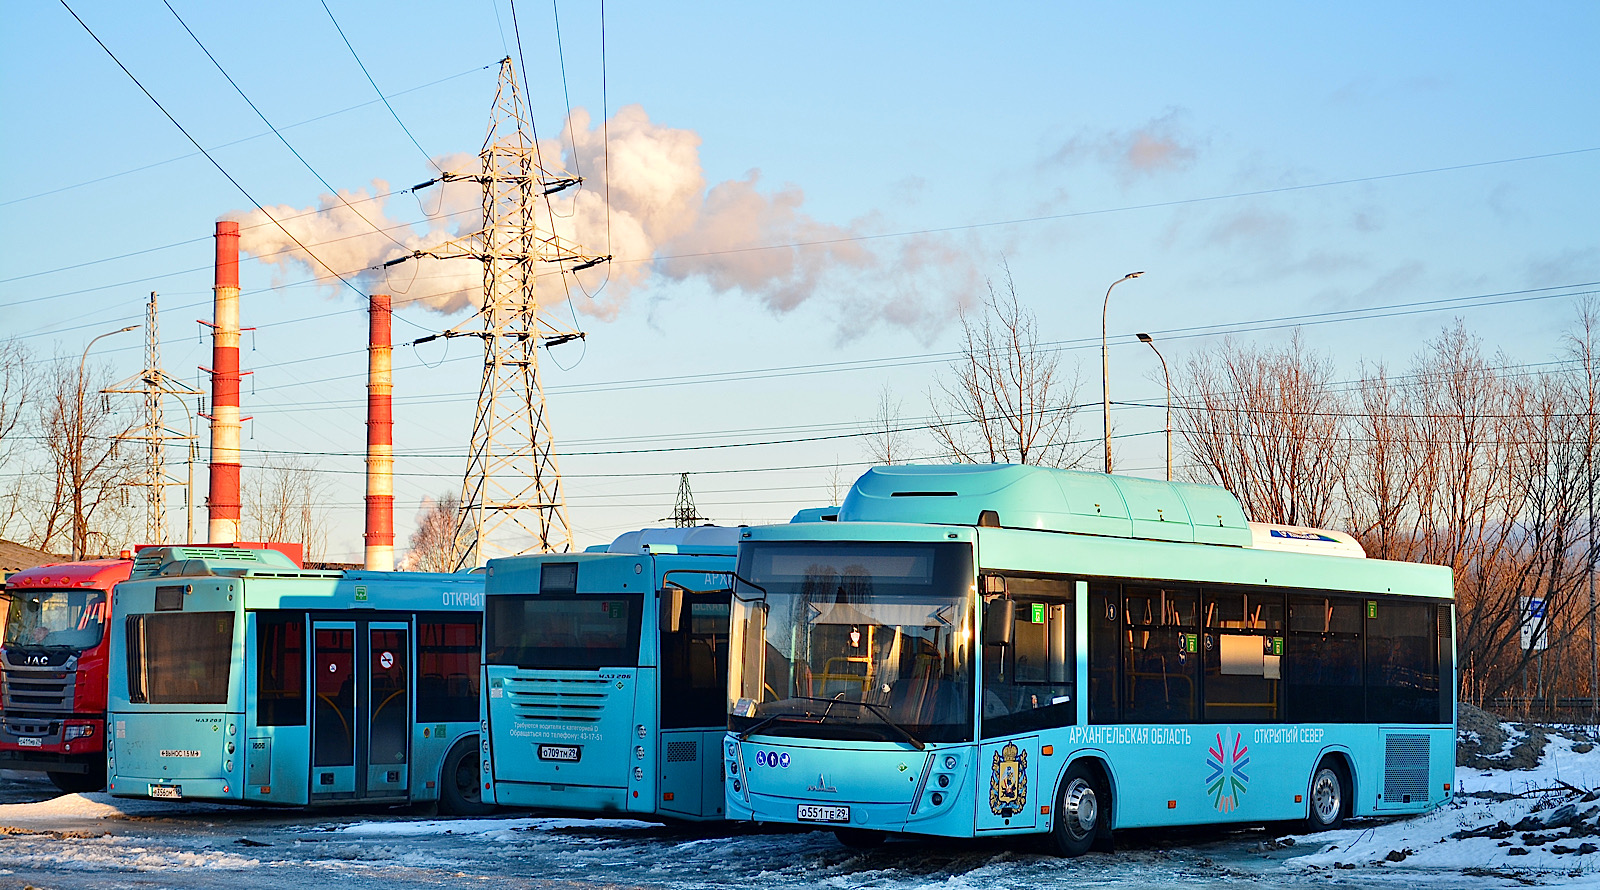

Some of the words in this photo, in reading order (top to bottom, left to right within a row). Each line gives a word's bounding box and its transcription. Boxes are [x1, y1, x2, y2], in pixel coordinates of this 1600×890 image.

[24, 656, 48, 665] JAC
[510, 729, 542, 738] Обращаться
[580, 733, 602, 741] 43-17-51
[1069, 727, 1149, 744] АРХАНГЕЛЬСКАЯ
[1151, 728, 1191, 745] ОБЛАСТЬ
[1254, 726, 1298, 744] ОТКРЫТЫЙ
[1300, 728, 1324, 743] СЕВЕР
